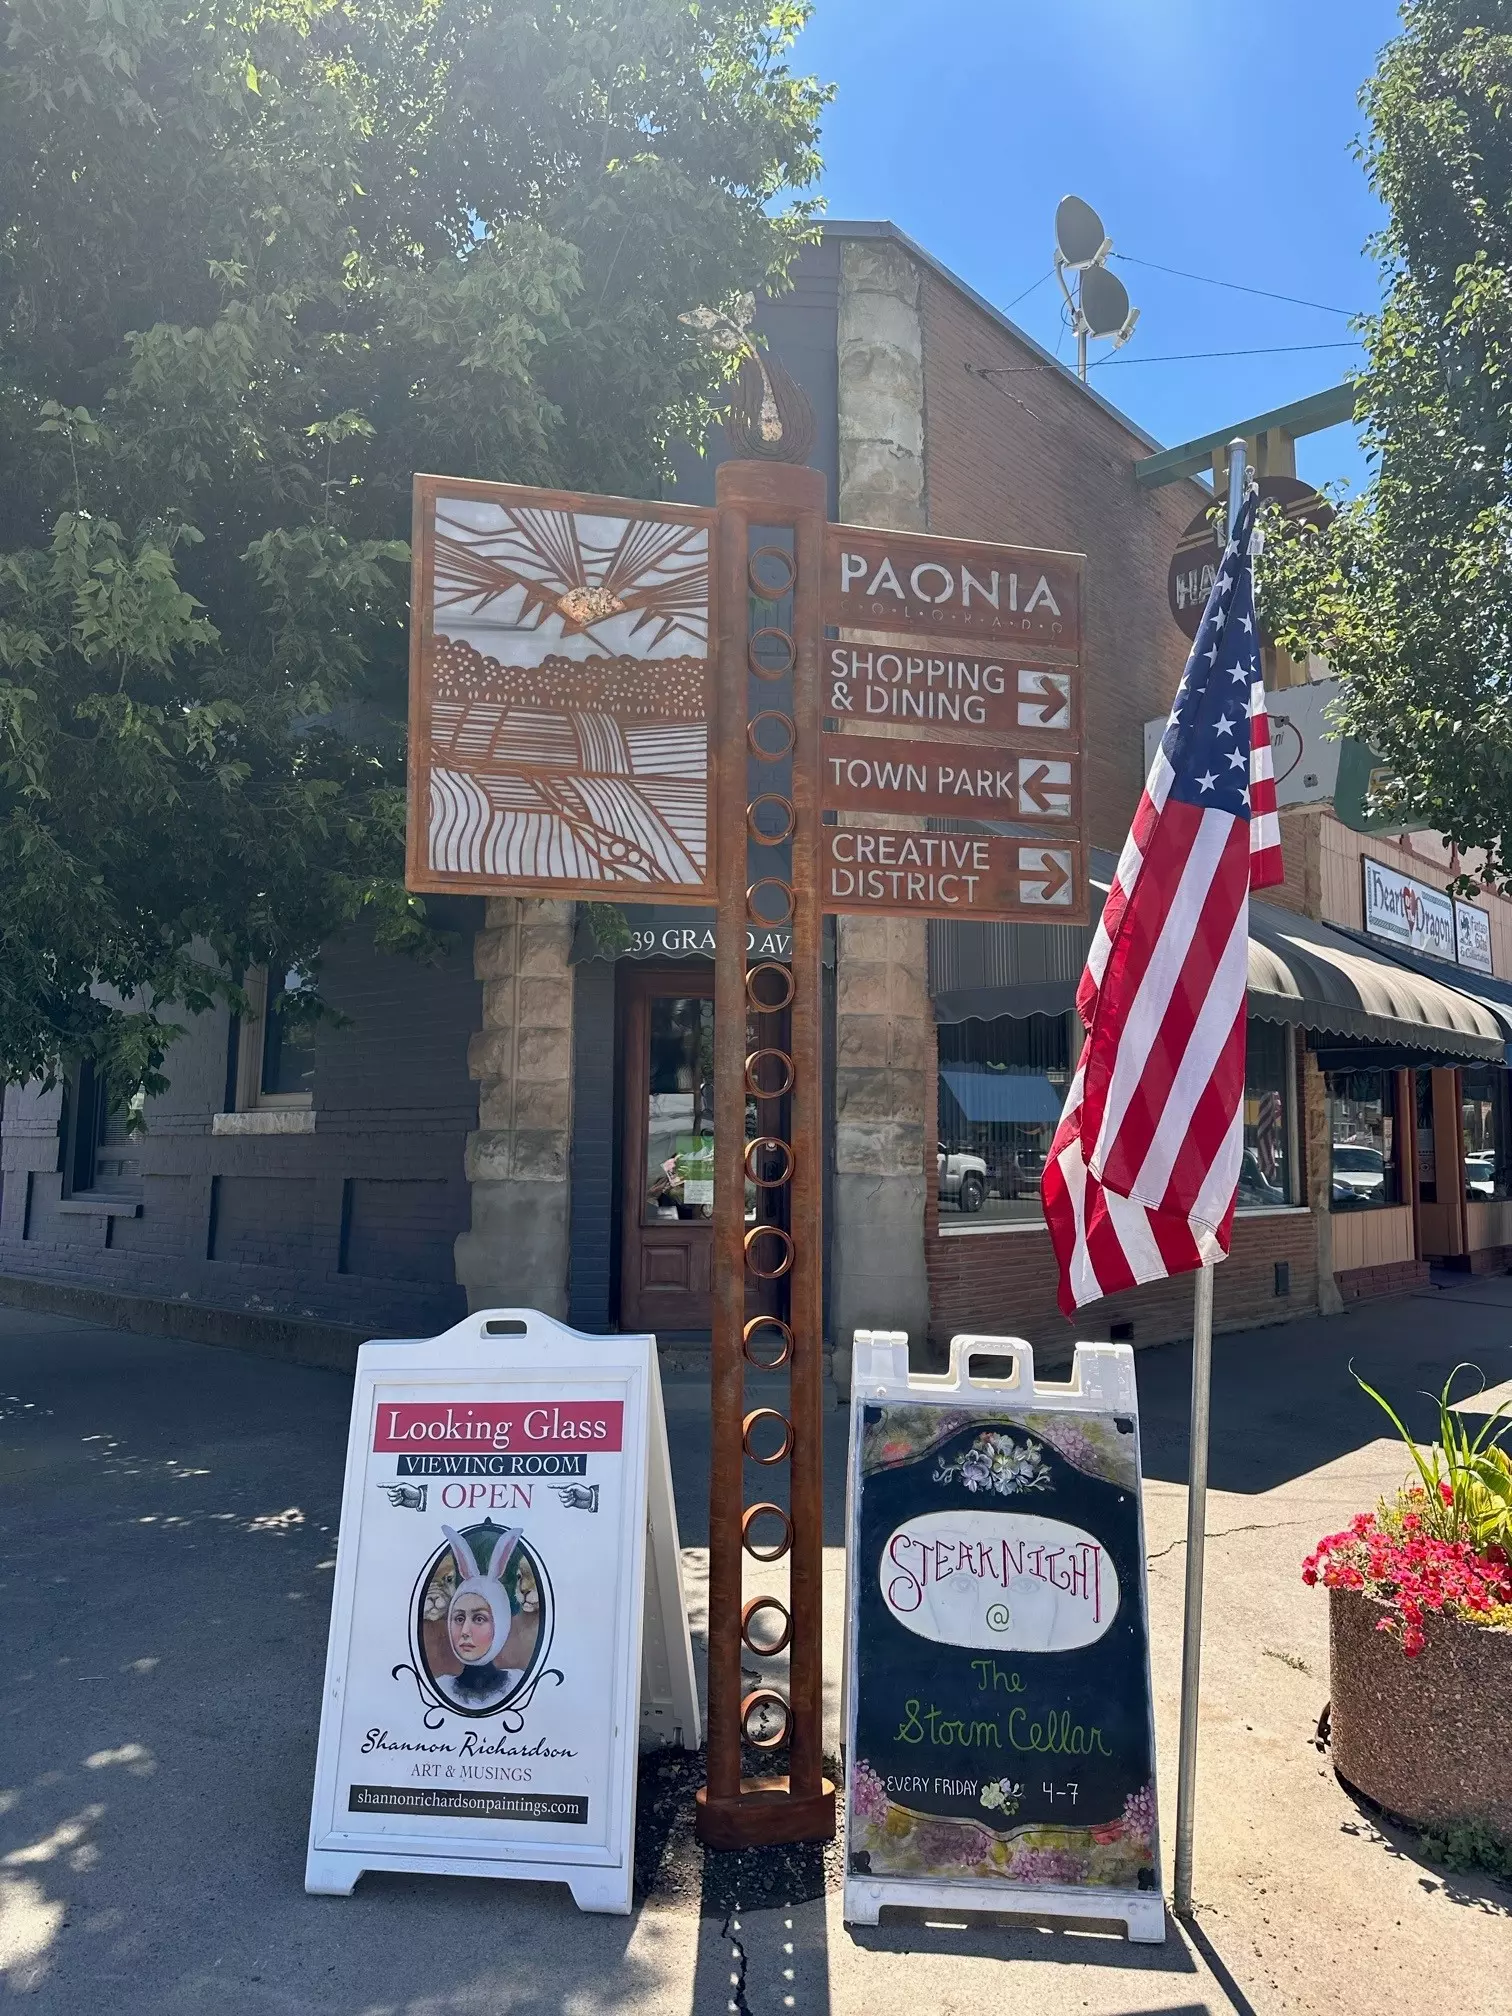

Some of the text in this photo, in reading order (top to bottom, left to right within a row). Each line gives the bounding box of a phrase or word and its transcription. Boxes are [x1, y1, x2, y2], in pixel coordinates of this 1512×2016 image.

[840, 552, 1062, 616] PAONIA
[831, 648, 1005, 694] SHOPPING
[831, 681, 987, 724] & DINING
[829, 757, 1014, 799] TOWN PARK
[832, 833, 990, 870] CREATIVE
[832, 867, 980, 903] DISTRICT
[1416, 896, 1451, 946] Dragon
[622, 929, 793, 955] 39 GRA AV
[386, 1408, 607, 1450] Looking Glass
[405, 1456, 580, 1474] VIEWING ROOM
[441, 1483, 535, 1509] OPEN
[888, 1534, 1101, 1623] STEAK NIGHT
[986, 1603, 1010, 1632] @
[971, 1659, 1027, 1692] The
[360, 1728, 578, 1758] Shannon Richardson
[893, 1699, 1112, 1757] Storm Cellar
[411, 1763, 532, 1782] ART & MUSINGS
[887, 1775, 1079, 1805] EVERY FRIDAY 4-7
[357, 1790, 580, 1816] shannonrichardsonpaintings.com
